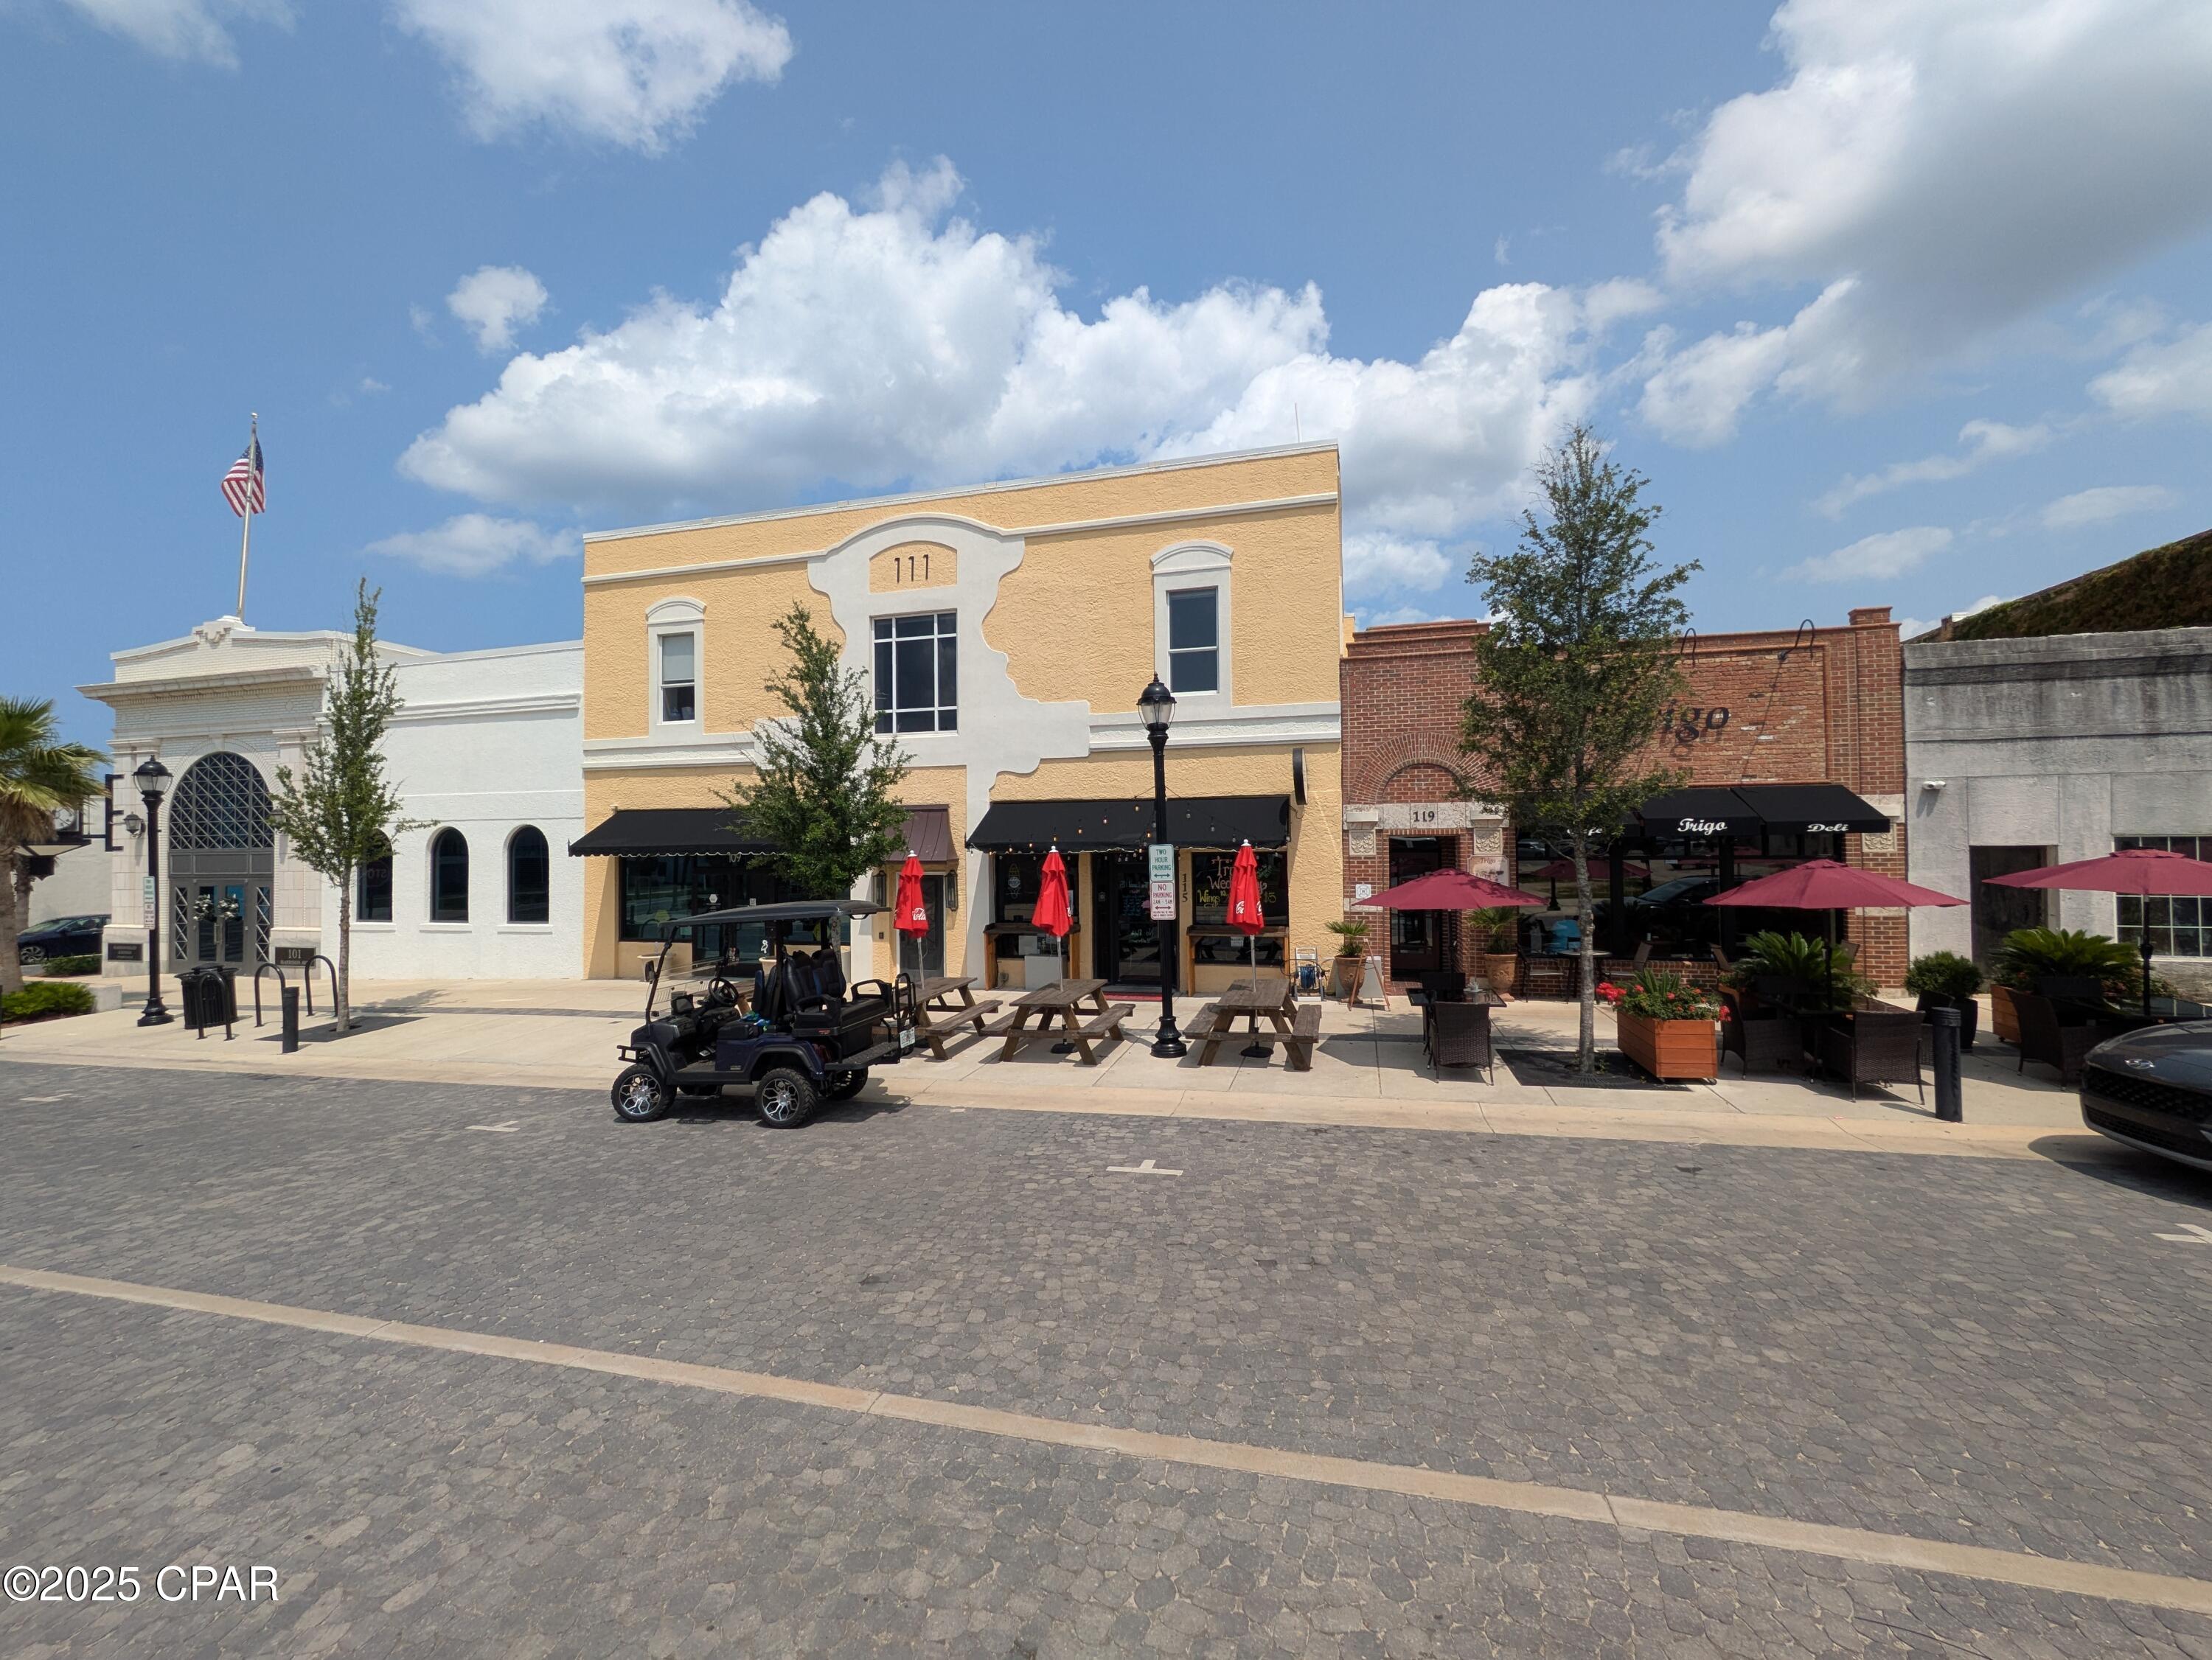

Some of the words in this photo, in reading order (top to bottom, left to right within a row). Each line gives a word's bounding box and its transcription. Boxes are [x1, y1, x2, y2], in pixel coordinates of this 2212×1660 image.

[894, 554, 929, 583] 111
[1413, 811, 1435, 822] 119
[1677, 817, 1728, 835] Trigo
[1806, 823, 1848, 832] Deli
[1197, 889, 1220, 906] Wings
[288, 949, 301, 959] 101
